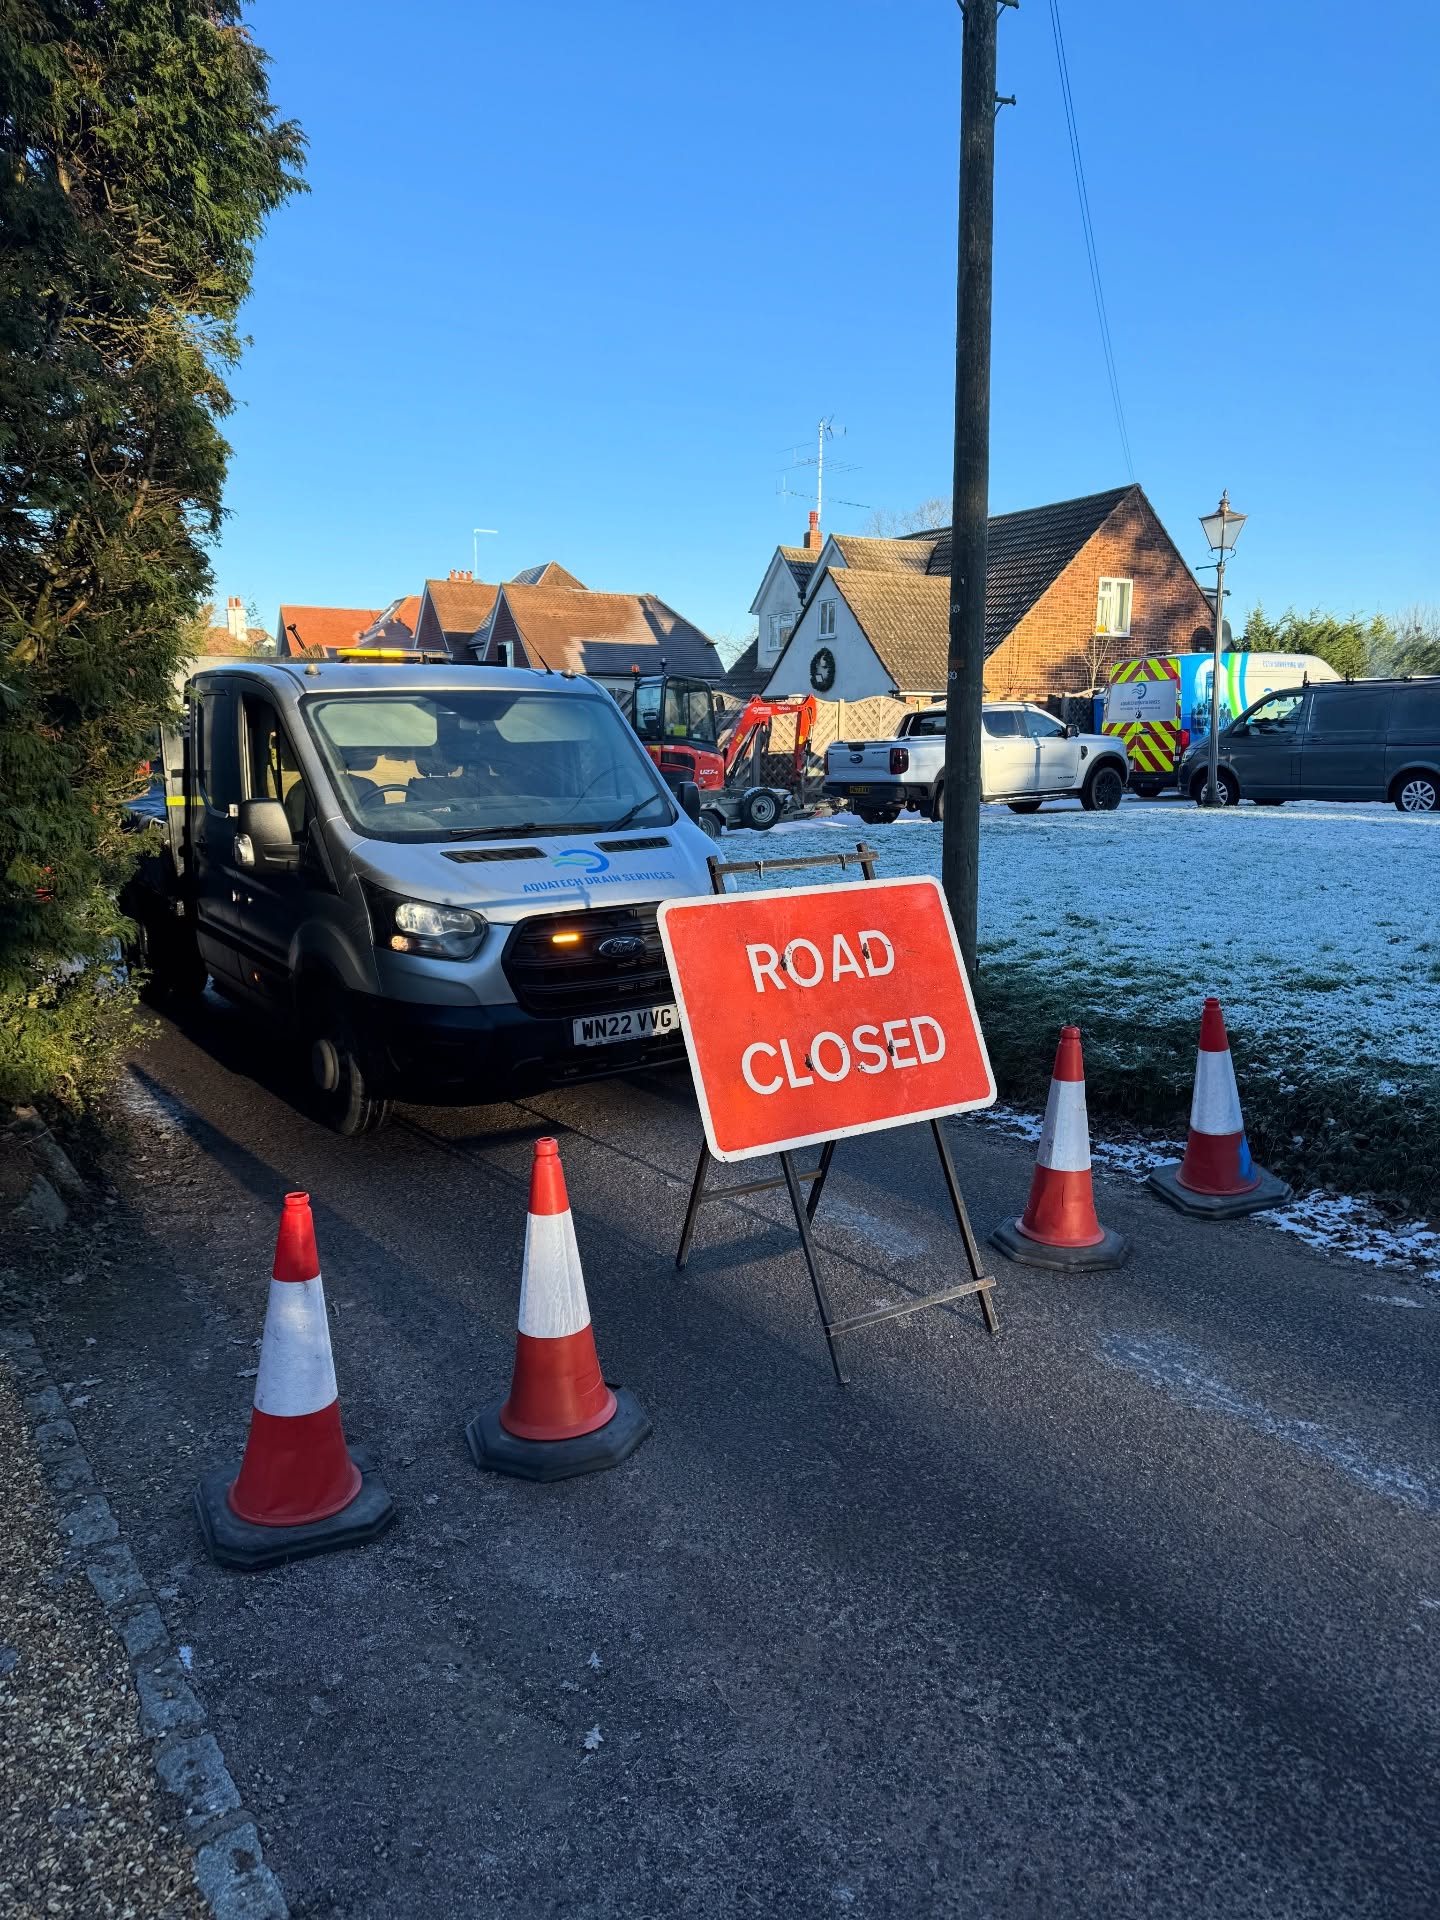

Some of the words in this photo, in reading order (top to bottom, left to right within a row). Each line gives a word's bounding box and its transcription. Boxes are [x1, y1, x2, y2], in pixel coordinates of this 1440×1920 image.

[523, 878, 584, 893] AQUATECH
[584, 875, 622, 885] DRAIN
[622, 871, 675, 882] SERVICES
[611, 940, 636, 953] Ford
[745, 929, 895, 993] ROAD
[581, 1015, 632, 1040] WN22
[637, 1008, 671, 1031] VVG
[741, 1015, 946, 1095] CLOSED
